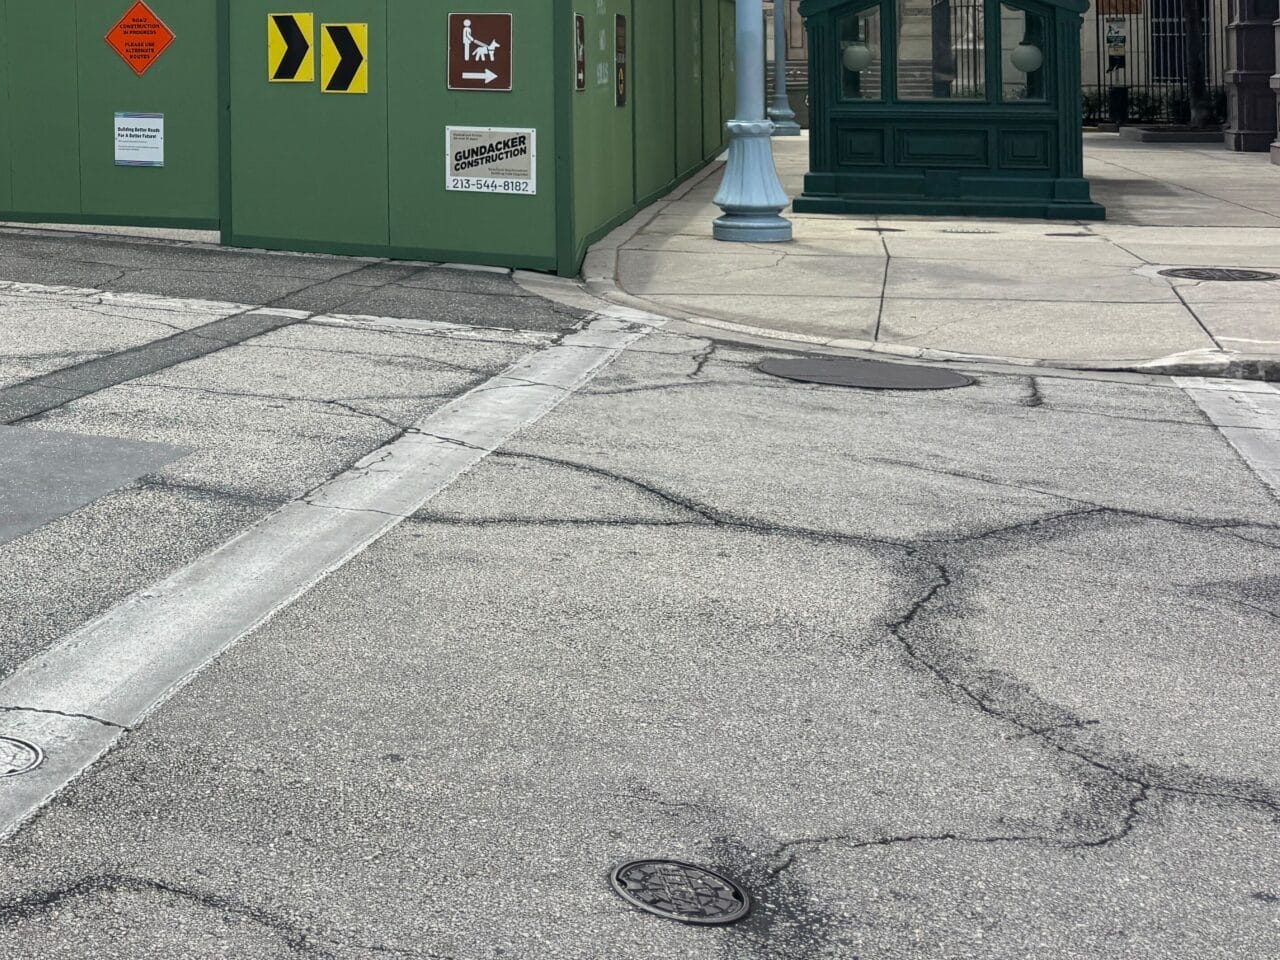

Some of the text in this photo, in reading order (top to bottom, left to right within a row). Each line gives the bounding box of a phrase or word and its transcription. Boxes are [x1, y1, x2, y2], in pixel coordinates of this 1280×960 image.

[454, 135, 527, 162] GUNDACKER
[454, 146, 527, 172] CONSTRUCTION
[452, 178, 529, 192] 213-544-8182
